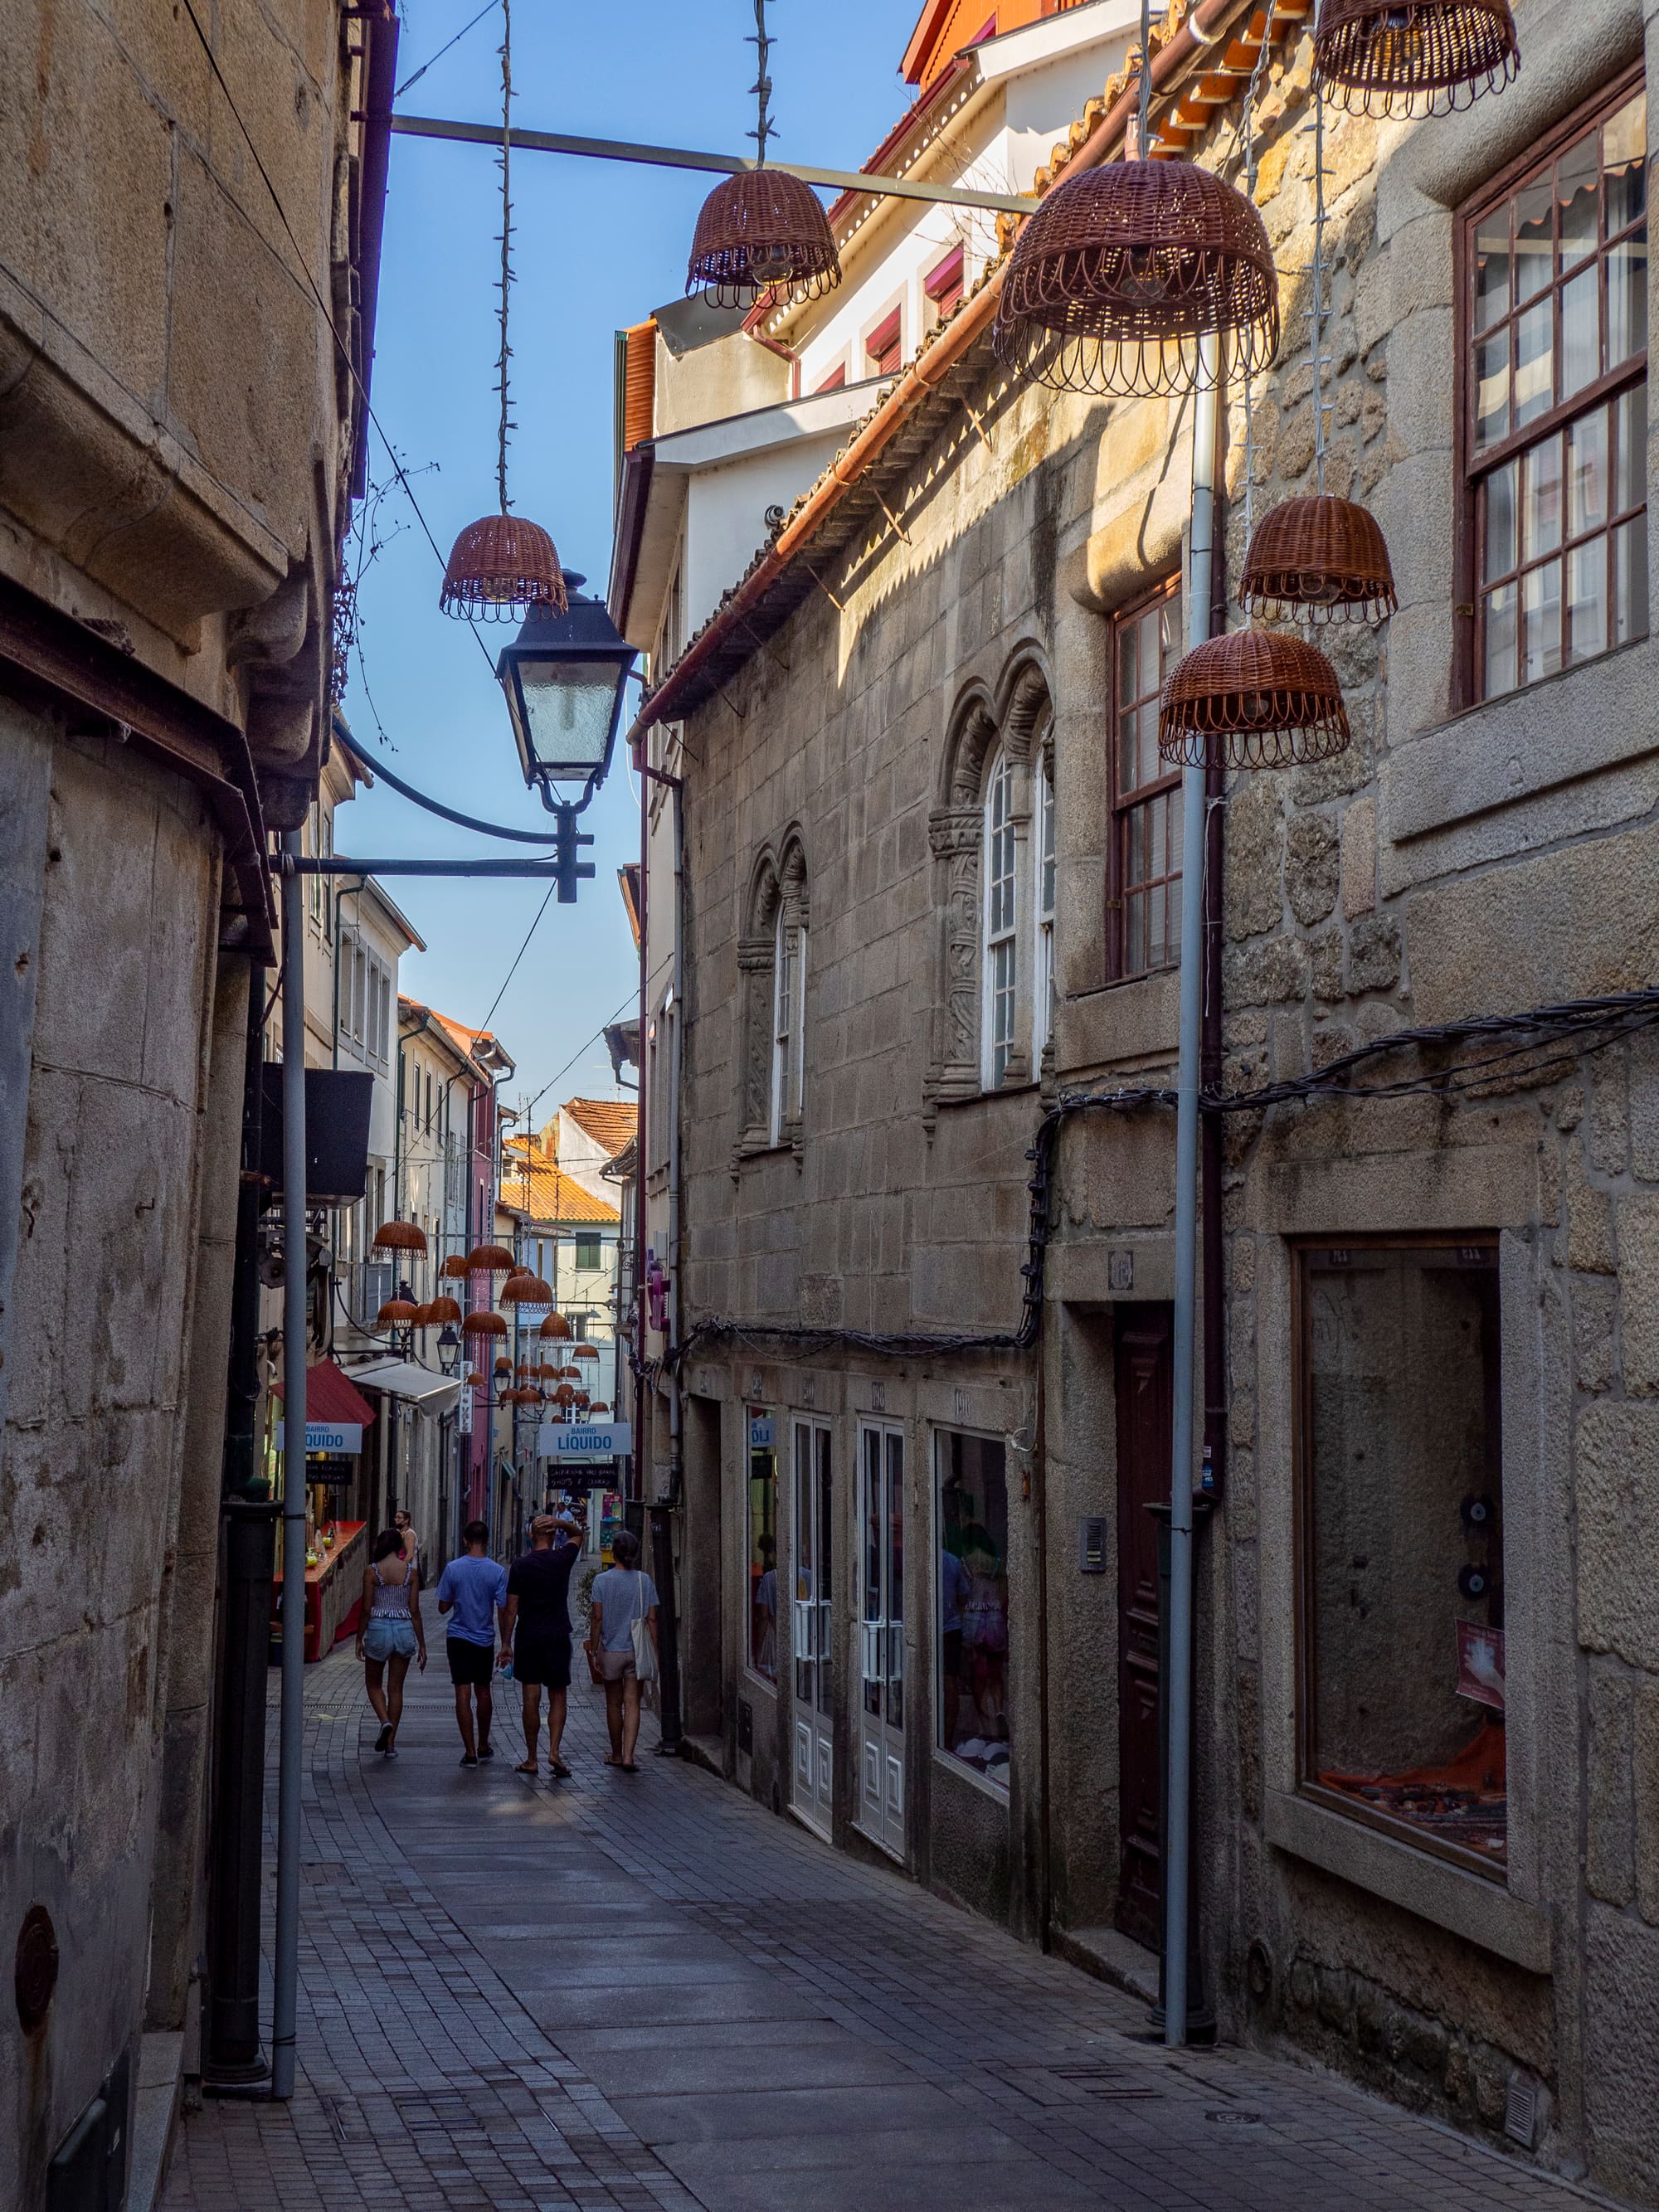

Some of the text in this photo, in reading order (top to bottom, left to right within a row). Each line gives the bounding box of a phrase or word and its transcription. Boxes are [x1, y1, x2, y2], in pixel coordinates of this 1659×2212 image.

[872, 1384, 884, 1407] 198
[305, 1434, 343, 1447] QUIDO
[557, 1433, 612, 1451] LÍQUIDO
